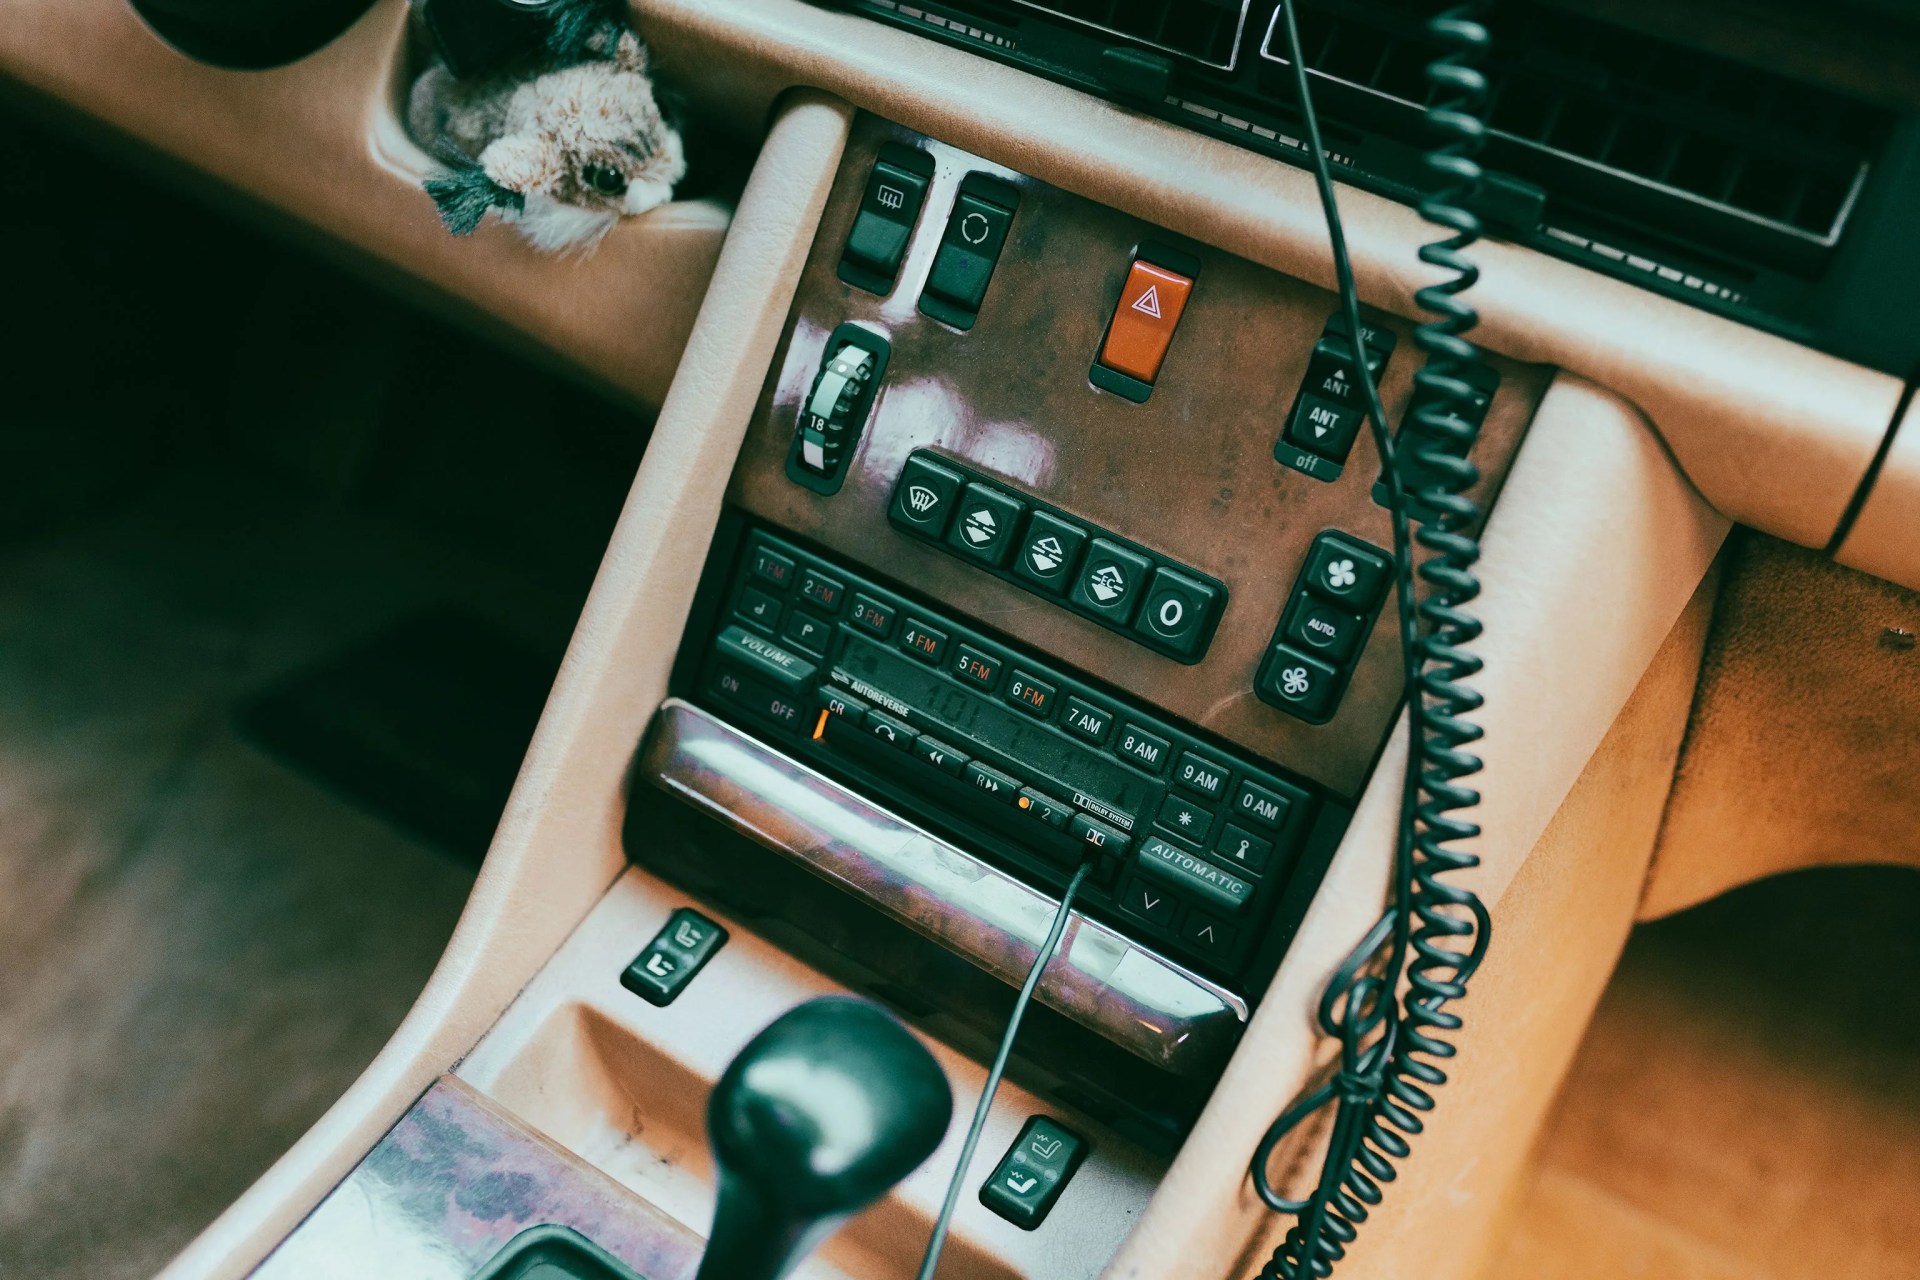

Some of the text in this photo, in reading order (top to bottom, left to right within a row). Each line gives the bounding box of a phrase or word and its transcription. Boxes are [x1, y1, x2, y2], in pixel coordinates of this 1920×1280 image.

[1323, 378, 1350, 396] ANT
[810, 416, 824, 431] 18
[1309, 406, 1340, 429] ANT
[1296, 455, 1318, 472] off
[758, 557, 785, 580] 1 FM
[804, 580, 834, 603] 2 FM
[1100, 574, 1115, 590] EC
[854, 604, 885, 628] 3 FM
[740, 635, 794, 667] VOLUME
[906, 630, 936, 654] 4 FM
[958, 655, 991, 681] 5 FM
[722, 674, 739, 693] ON
[1012, 681, 1045, 707] 6 FM
[771, 700, 795, 721] OFF
[829, 698, 845, 716] CR
[850, 681, 910, 717] AUTOREVERSE
[1068, 708, 1101, 735] 7 AM
[1123, 736, 1157, 762] 8 AM
[976, 773, 986, 788] R
[1183, 765, 1218, 792] 9 AM
[1041, 807, 1051, 820] 2
[1090, 803, 1131, 828] DOLBY SYSTEM
[1242, 793, 1279, 821] 0 AM
[1150, 843, 1243, 895] AUTOMATIC
